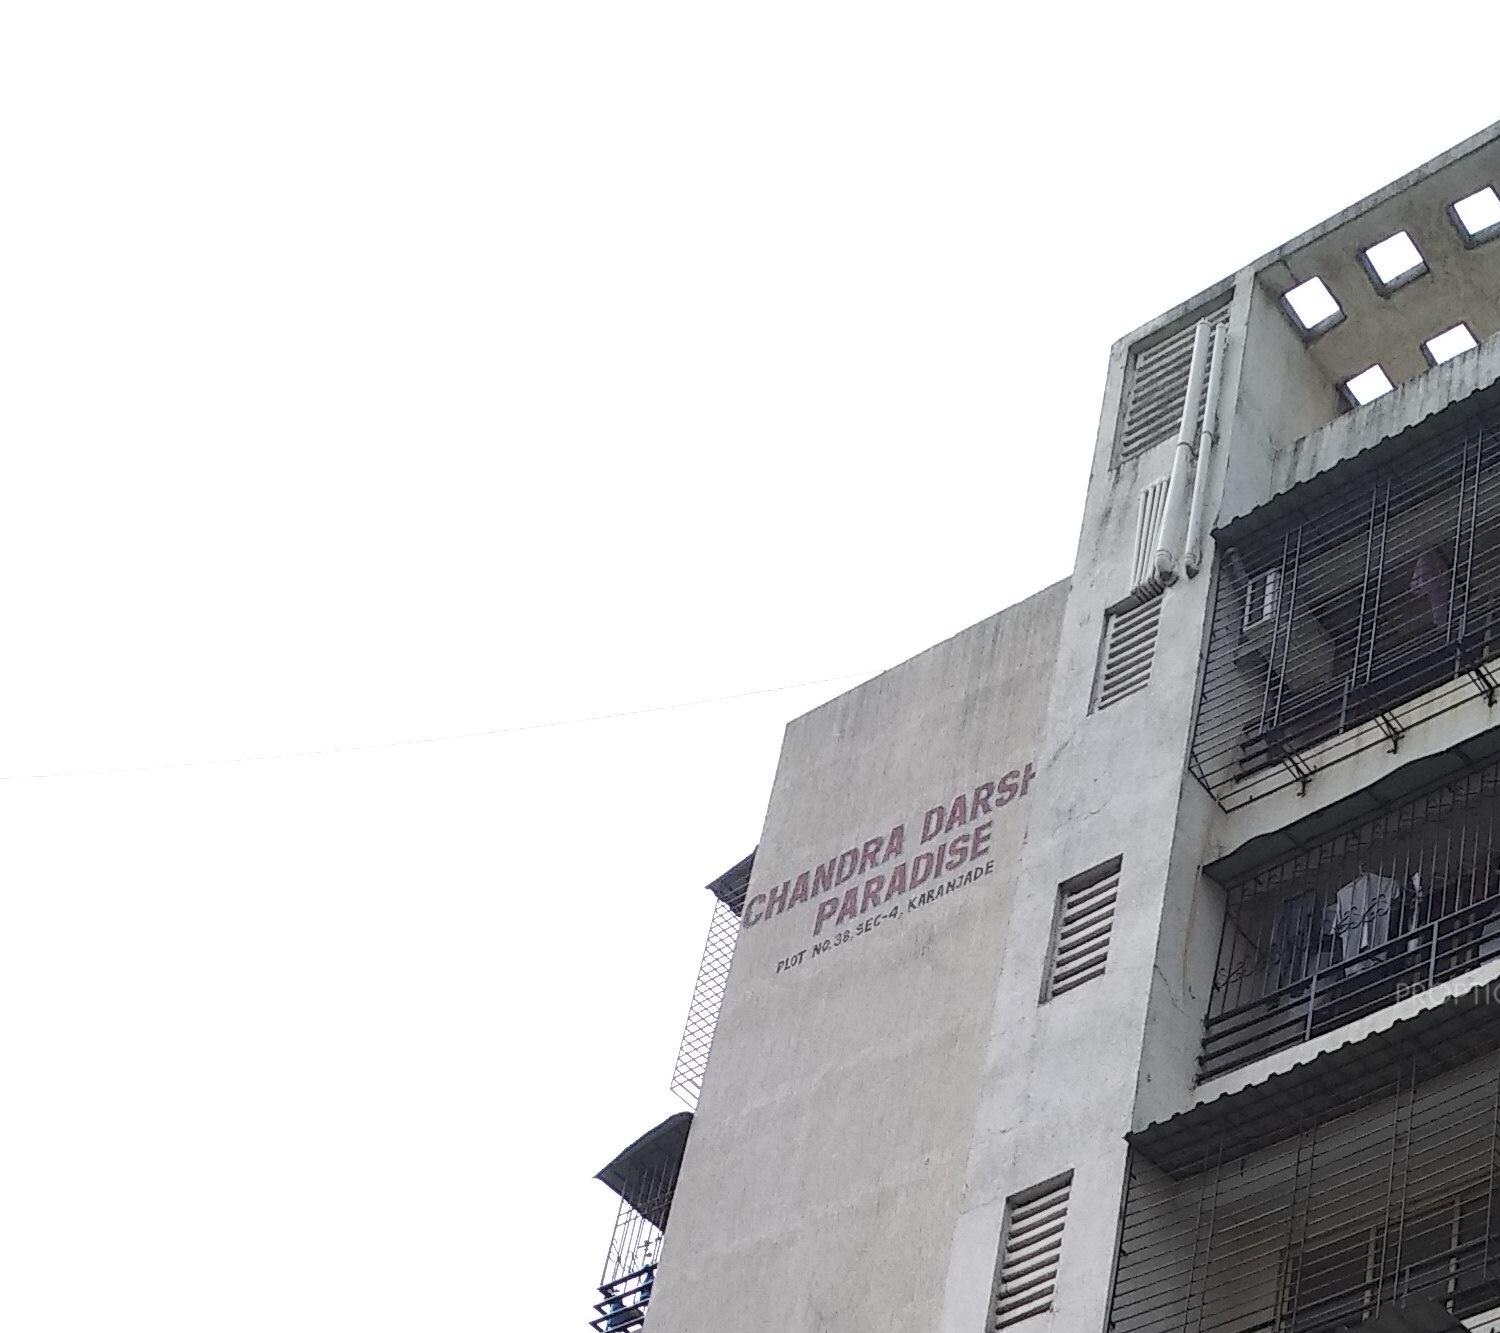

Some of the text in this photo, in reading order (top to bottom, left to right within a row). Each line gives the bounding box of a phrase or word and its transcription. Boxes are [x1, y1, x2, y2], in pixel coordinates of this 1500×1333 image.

[741, 824, 905, 929] CHANDRA
[776, 950, 807, 974] PLOT
[907, 860, 995, 913] KARANJADE
[812, 820, 993, 936] PARADISE
